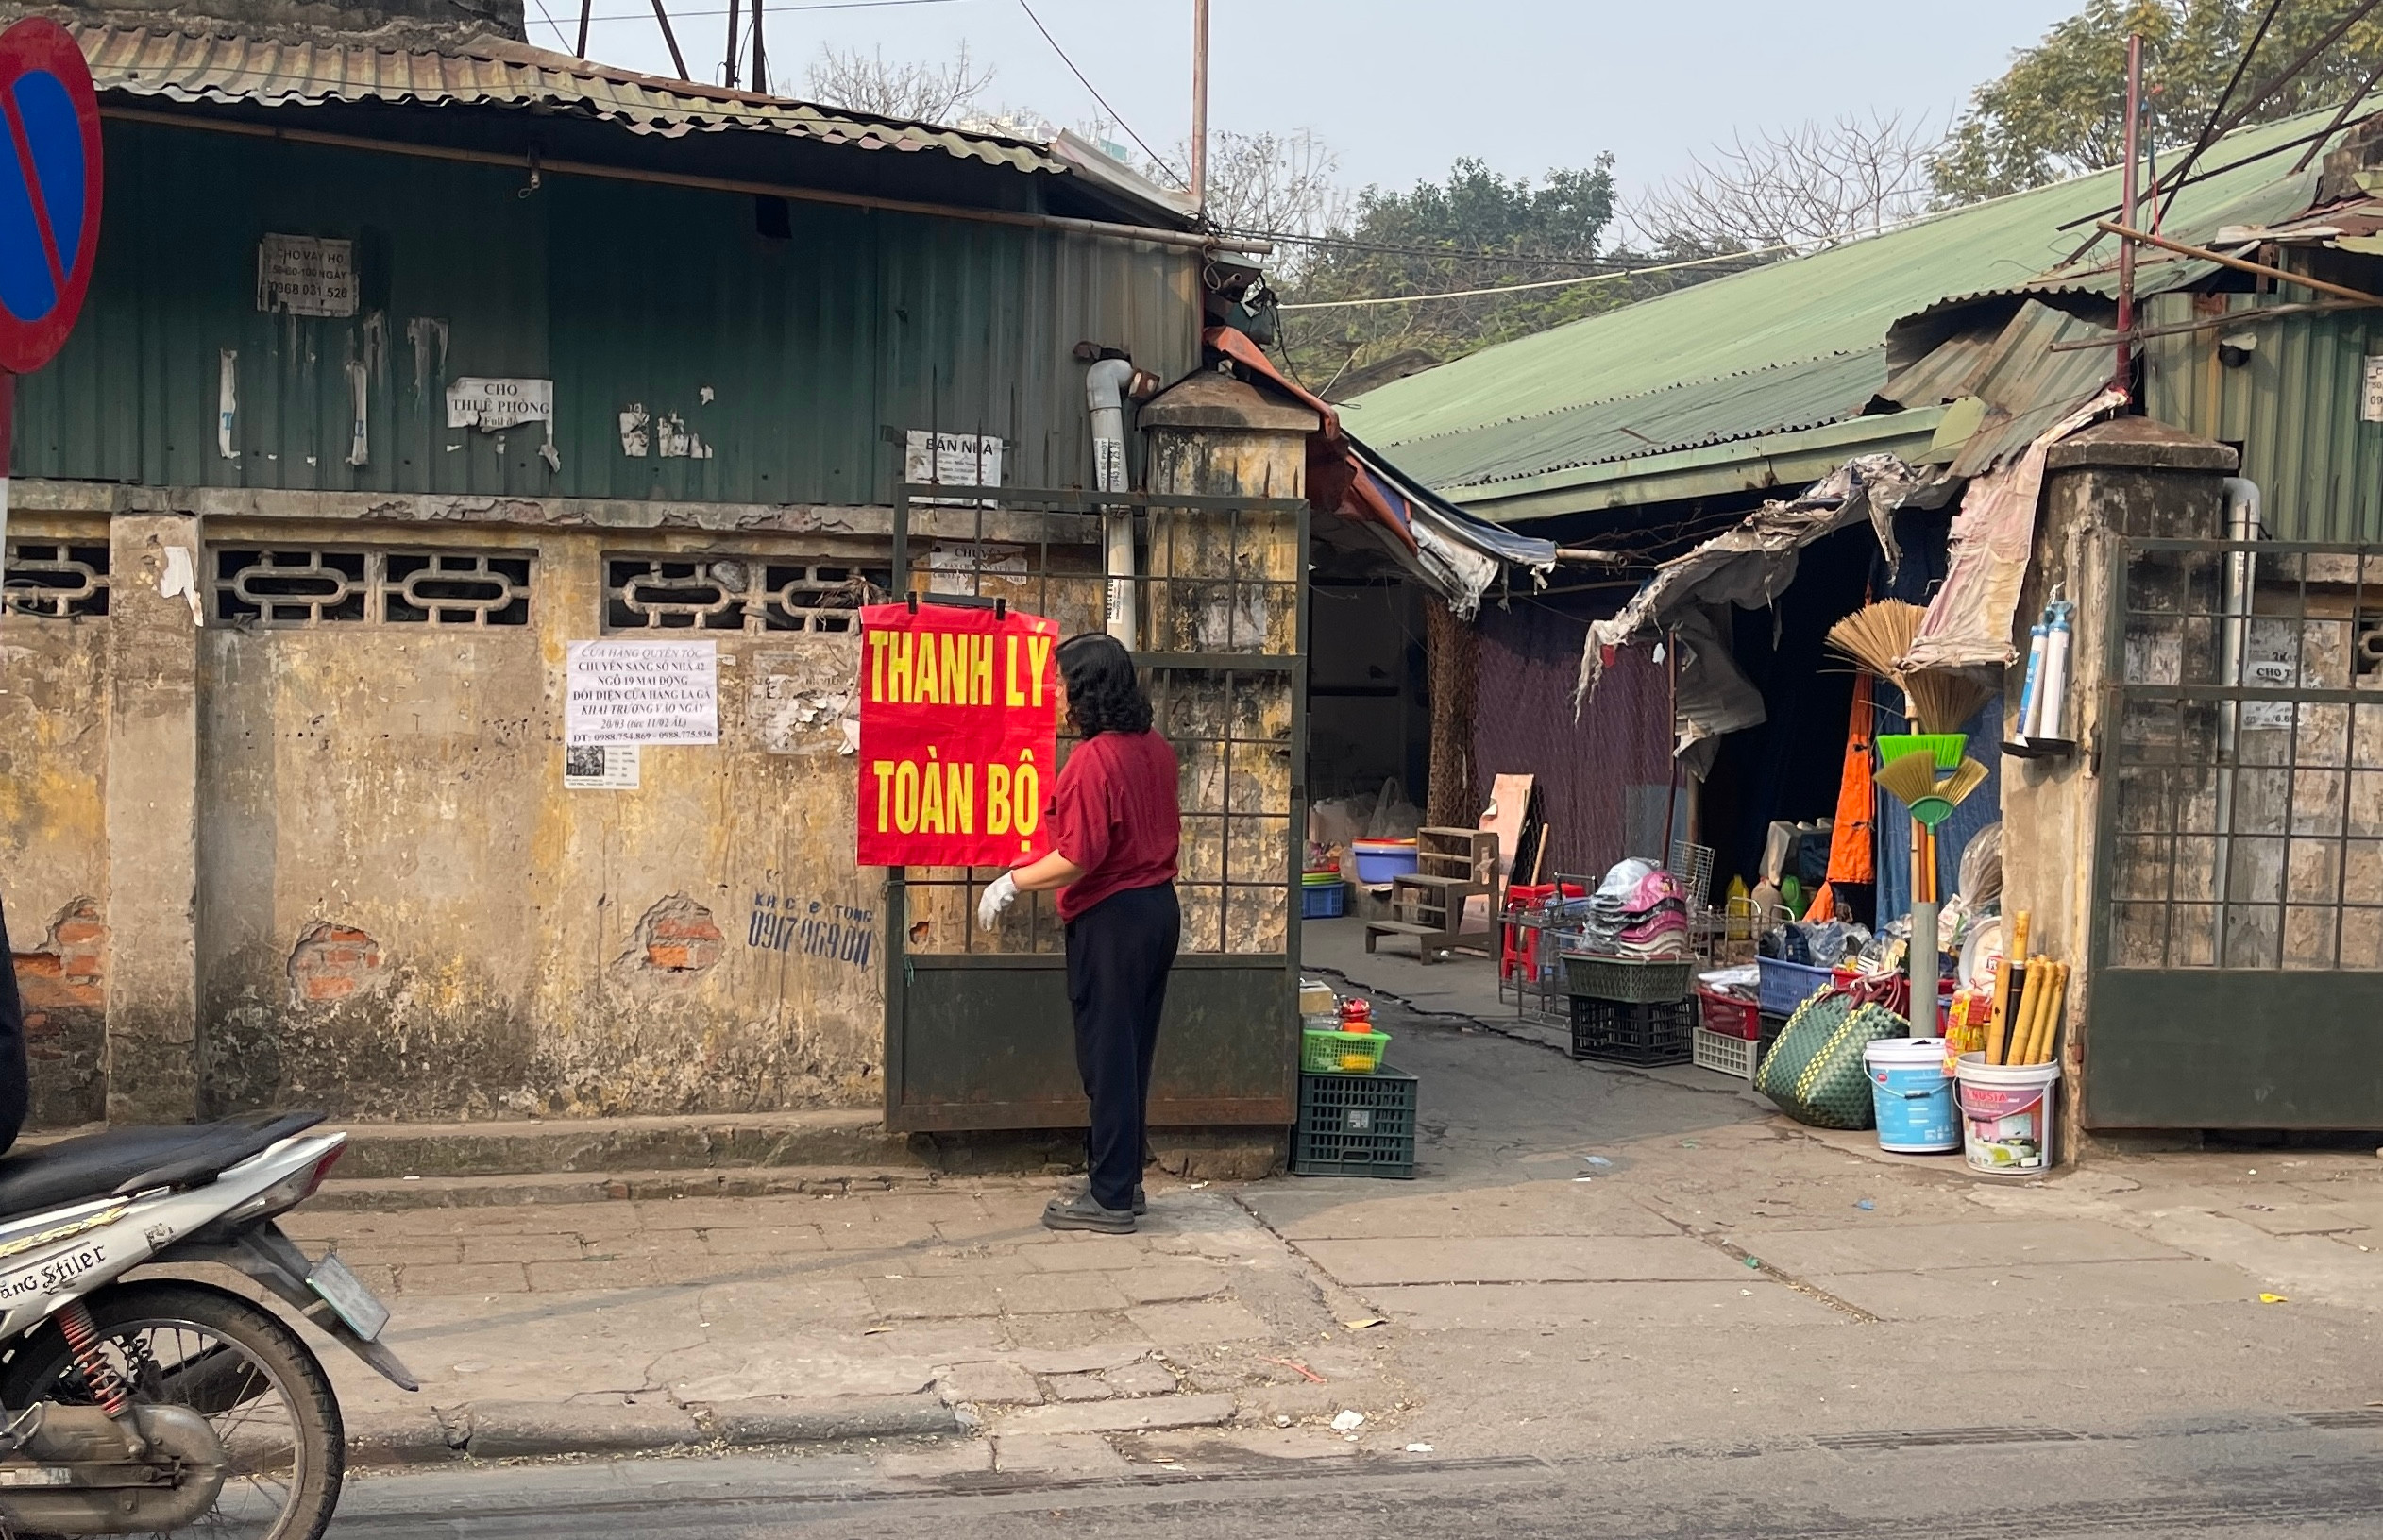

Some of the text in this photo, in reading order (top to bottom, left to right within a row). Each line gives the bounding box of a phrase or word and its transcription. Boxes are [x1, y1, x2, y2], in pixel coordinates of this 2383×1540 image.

[484, 382, 518, 397] CHO
[452, 397, 494, 413] THUÊ
[498, 398, 549, 415] PHÒNG
[925, 435, 957, 452] BÁN
[625, 662, 653, 672] SANG
[671, 659, 694, 672] NHÀ
[695, 662, 705, 672] 42
[868, 621, 1052, 708] THANH LÝ
[2256, 667, 2282, 678] CHO
[624, 676, 634, 686] 19
[636, 676, 657, 686] MAI
[596, 689, 622, 702] DIỆN
[649, 688, 679, 701] HÀNG
[581, 704, 608, 716] KHAI
[655, 702, 676, 714] VÀO
[601, 719, 625, 730] 20/03
[647, 717, 669, 728] 11/02
[873, 745, 1039, 854] TOÀN BỘ
